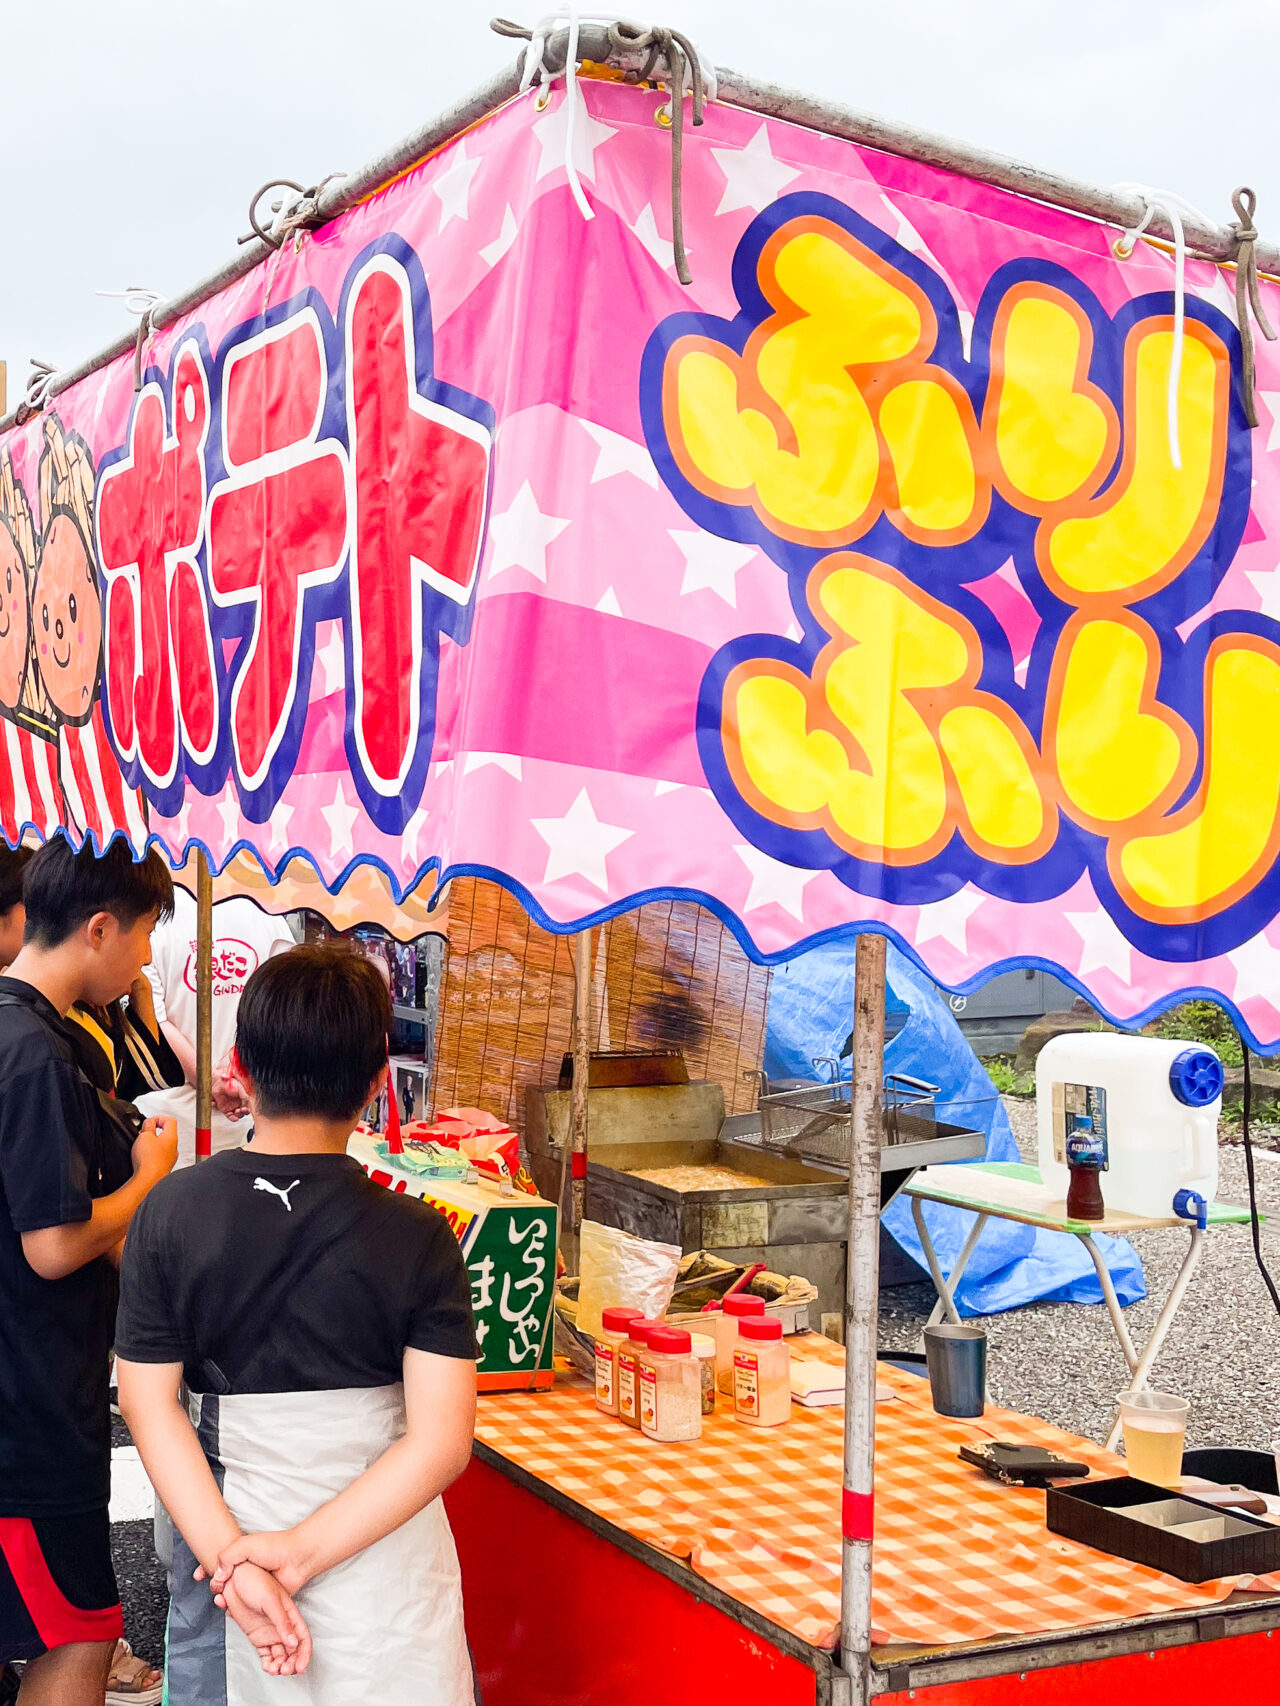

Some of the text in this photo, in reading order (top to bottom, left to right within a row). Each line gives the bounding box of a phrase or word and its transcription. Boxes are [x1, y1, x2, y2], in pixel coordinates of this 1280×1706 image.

[94, 250, 494, 800] ポテト
[655, 205, 1235, 613] ふり
[714, 549, 1280, 930] ふり
